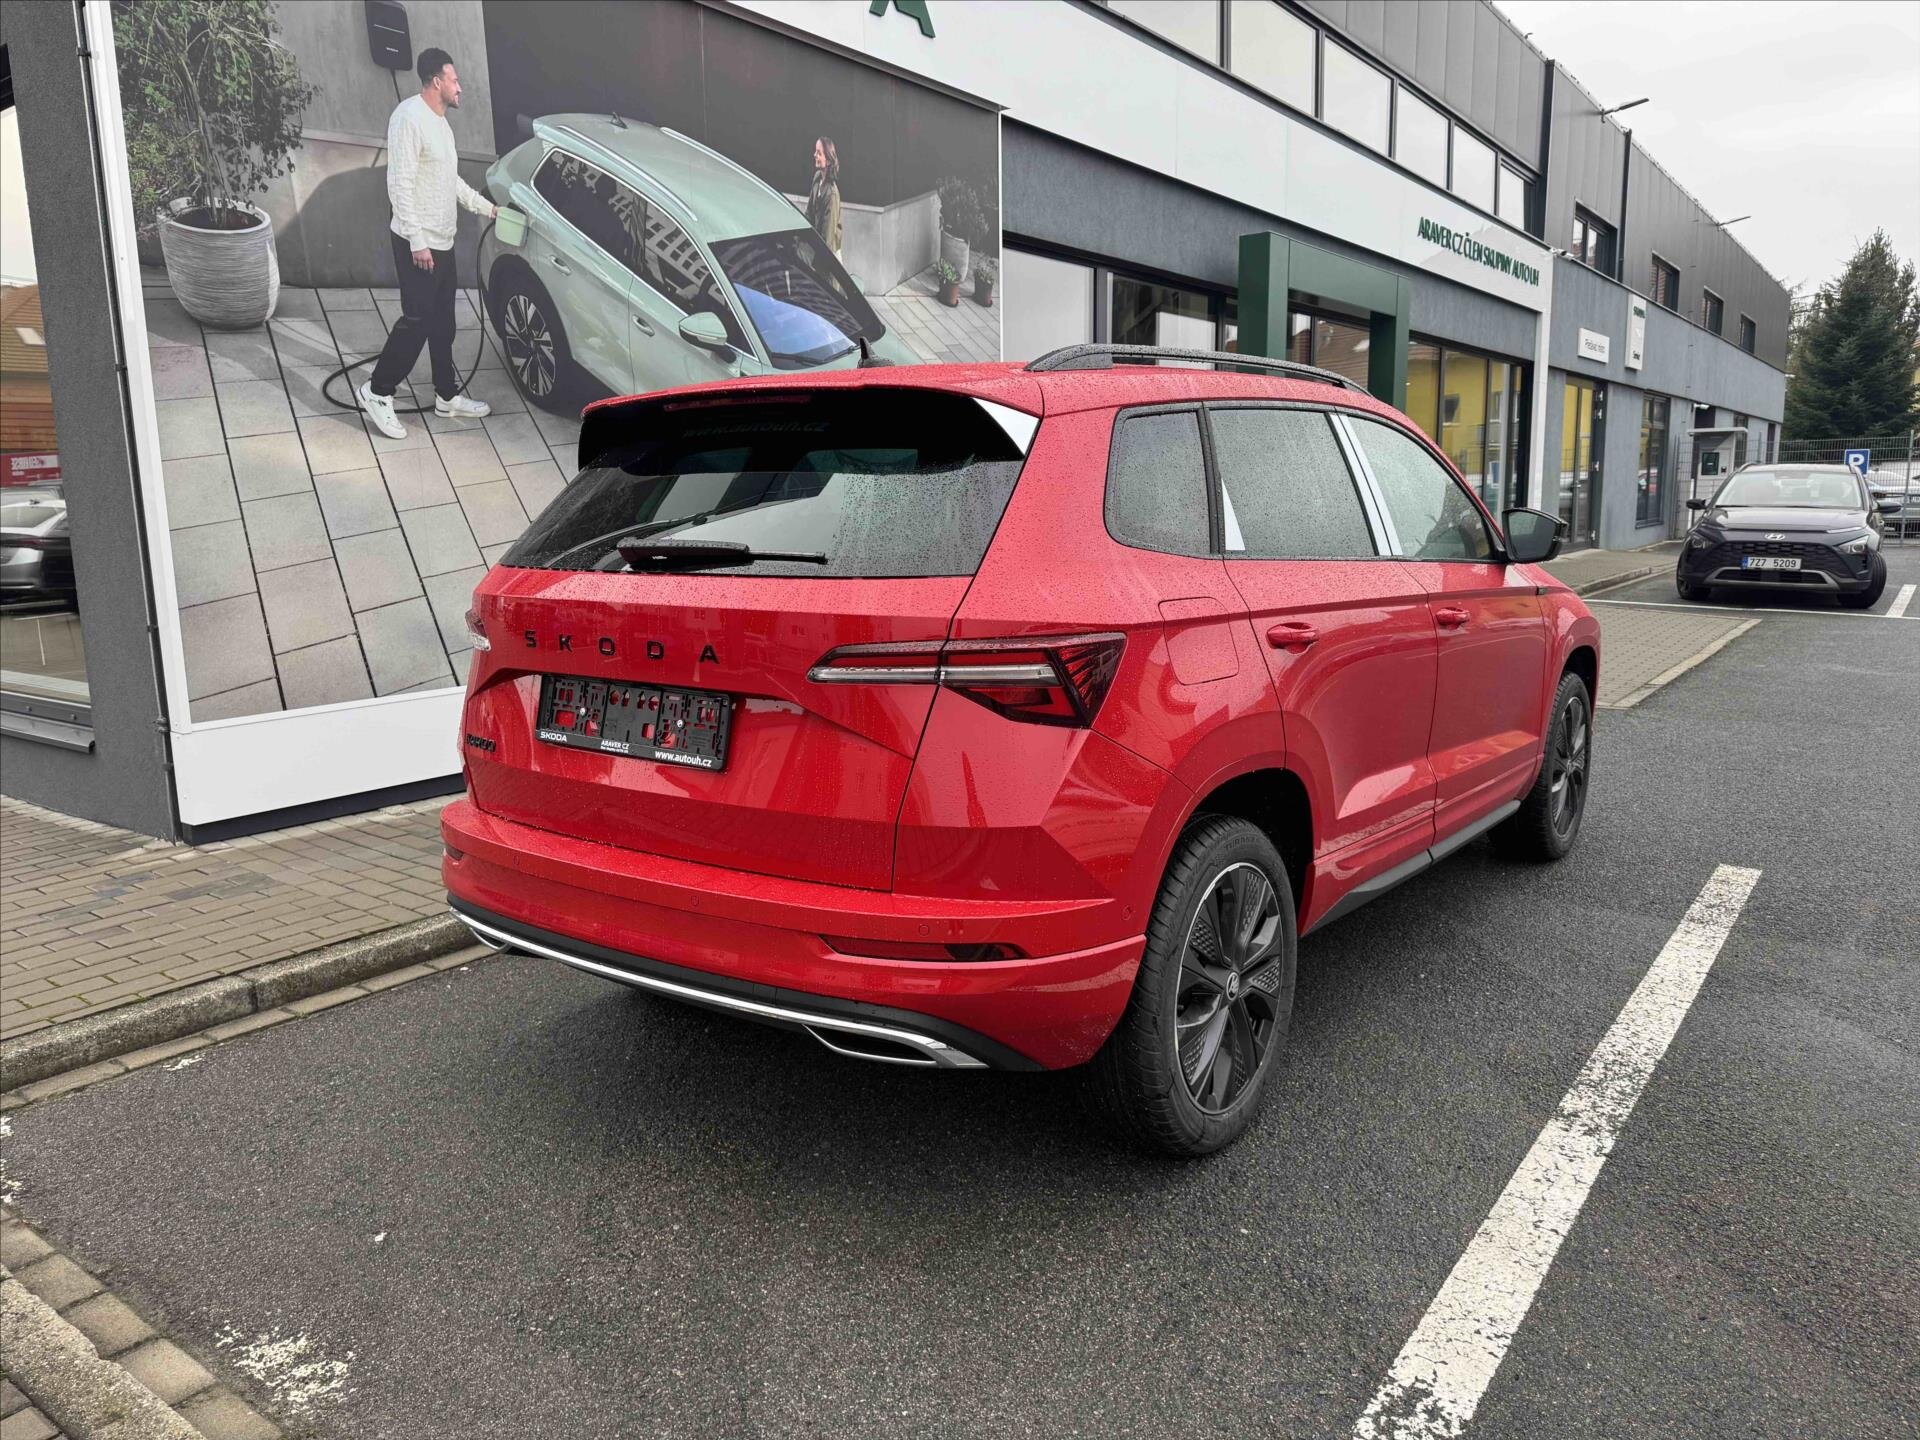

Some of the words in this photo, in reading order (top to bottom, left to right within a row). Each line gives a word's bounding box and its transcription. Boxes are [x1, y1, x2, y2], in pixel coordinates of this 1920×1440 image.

[1417, 217, 1452, 250] ARAVER
[1452, 232, 1464, 255] CZ
[1463, 232, 1483, 263] ČLEN
[1848, 453, 1865, 467] P
[1750, 558, 1767, 567] 7Z7
[1773, 559, 1797, 568] 5209
[655, 750, 712, 767] www.autouh.cz
